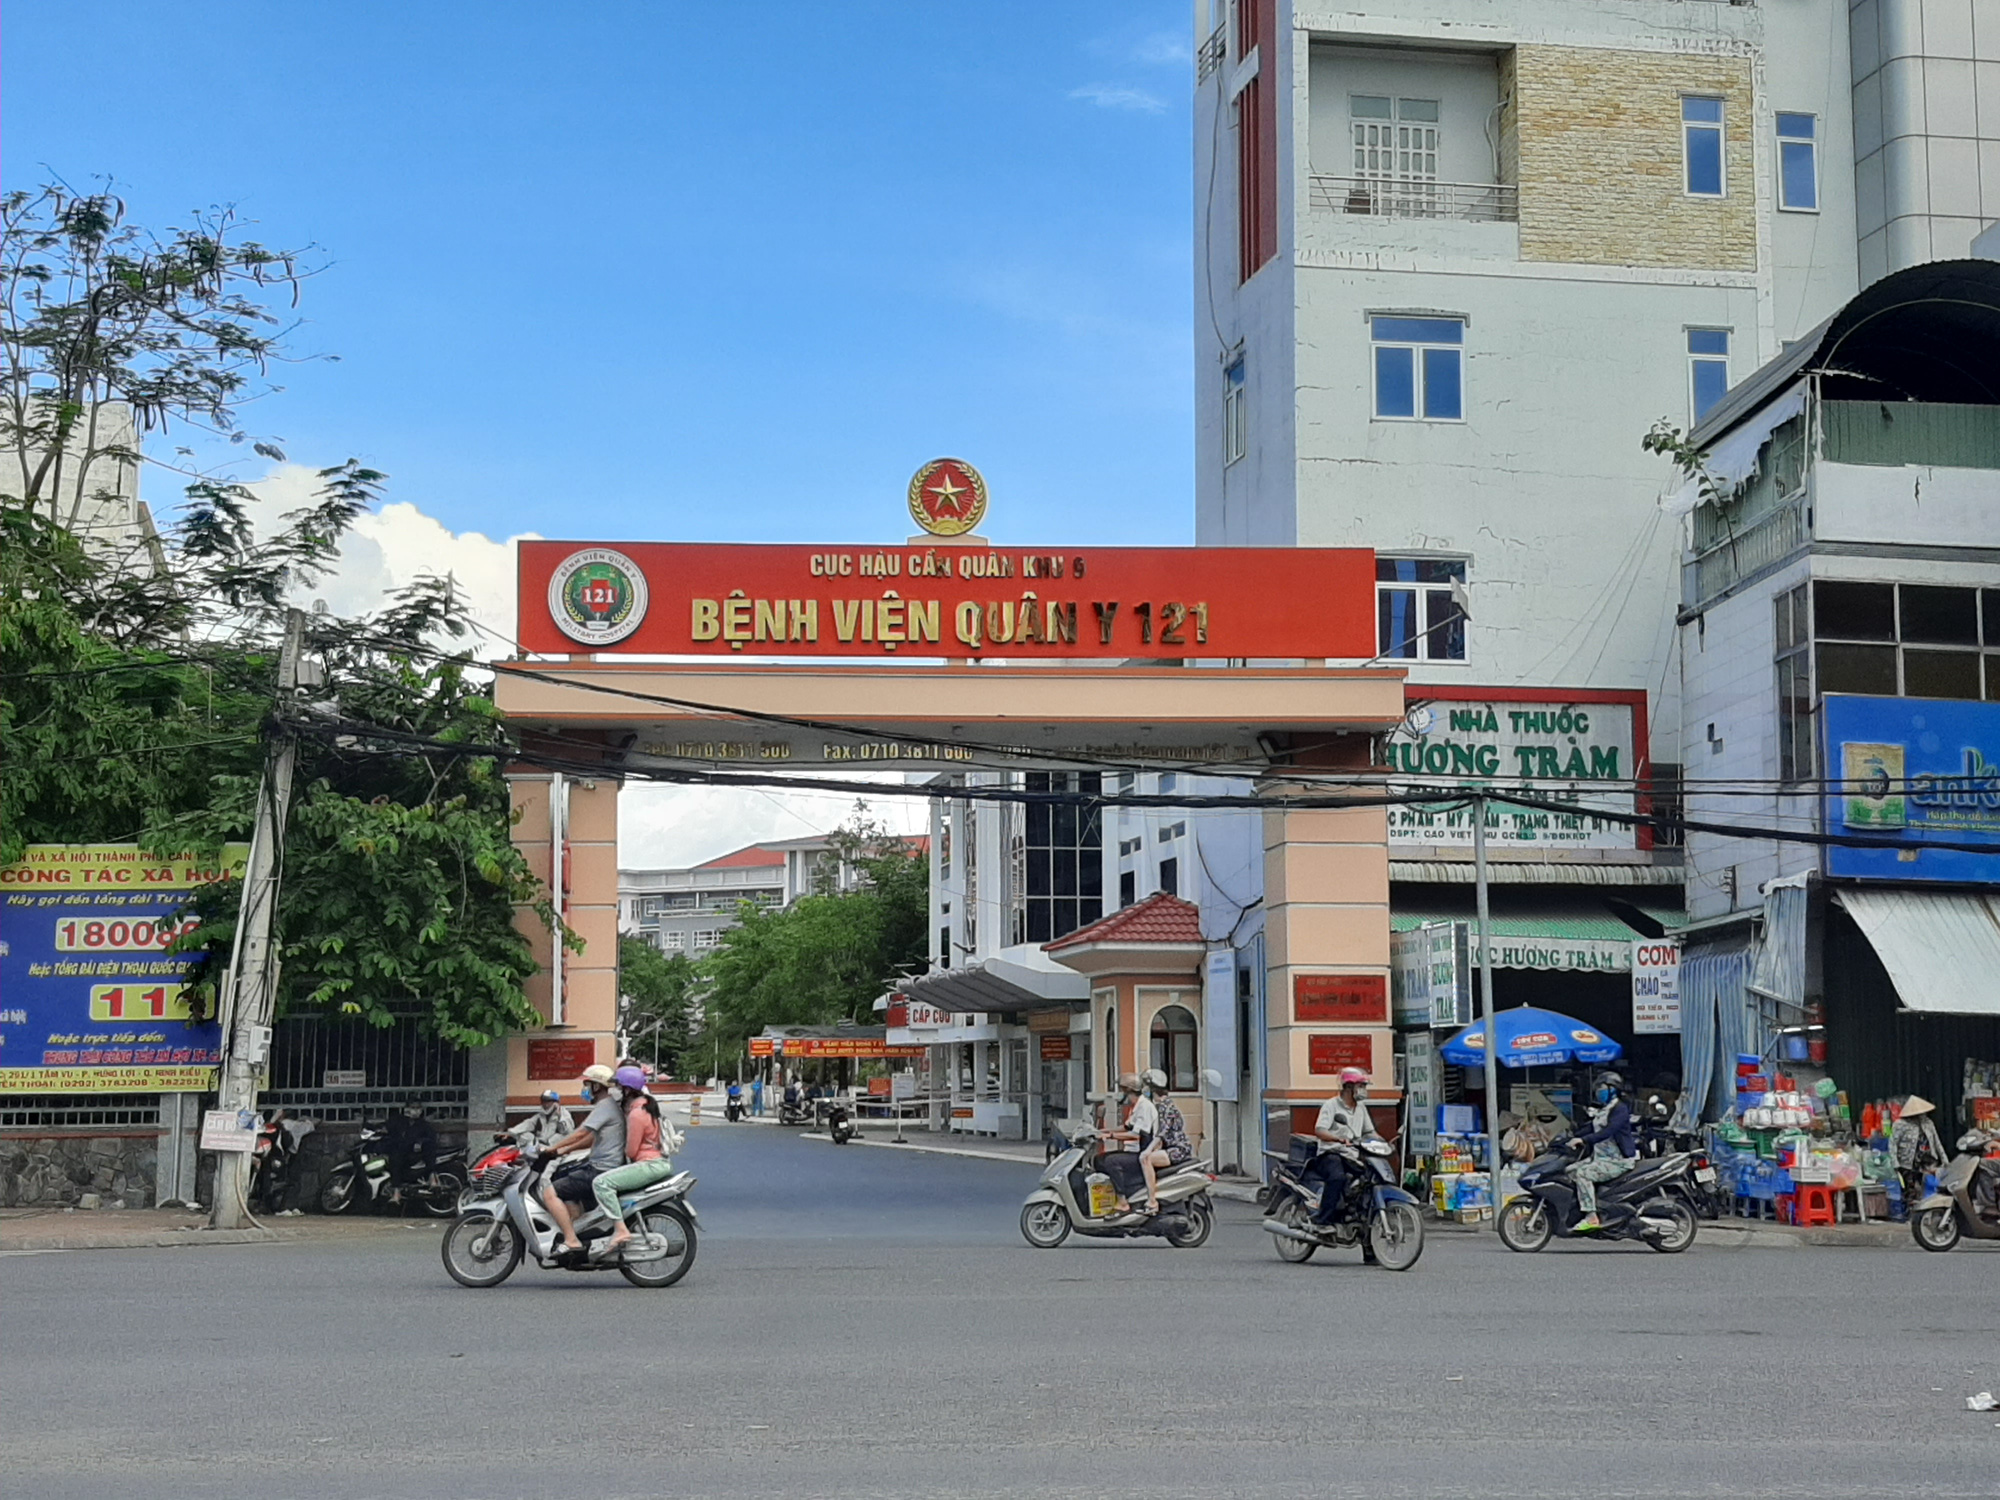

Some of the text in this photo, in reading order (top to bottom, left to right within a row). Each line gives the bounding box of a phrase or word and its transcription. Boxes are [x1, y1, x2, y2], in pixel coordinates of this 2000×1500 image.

[810, 553, 853, 580] CỤC
[859, 550, 900, 580] HẬU
[959, 552, 1014, 580] QUÂN
[1023, 556, 1065, 578] KHU
[1073, 556, 1085, 578] 9
[583, 588, 615, 603] 121
[691, 589, 1208, 650] BỆNH VIỆN QUÂN Y 121
[1449, 703, 1590, 734] NHÀ THUỐC
[1513, 736, 1619, 778] TRÀM
[1512, 813, 1549, 829] TRANG
[0, 866, 71, 883] CÔNG
[80, 865, 132, 882] TÁC
[141, 865, 174, 882] XÃ
[1498, 945, 1560, 966] HƯƠNG
[912, 1004, 930, 1023] CẤP
